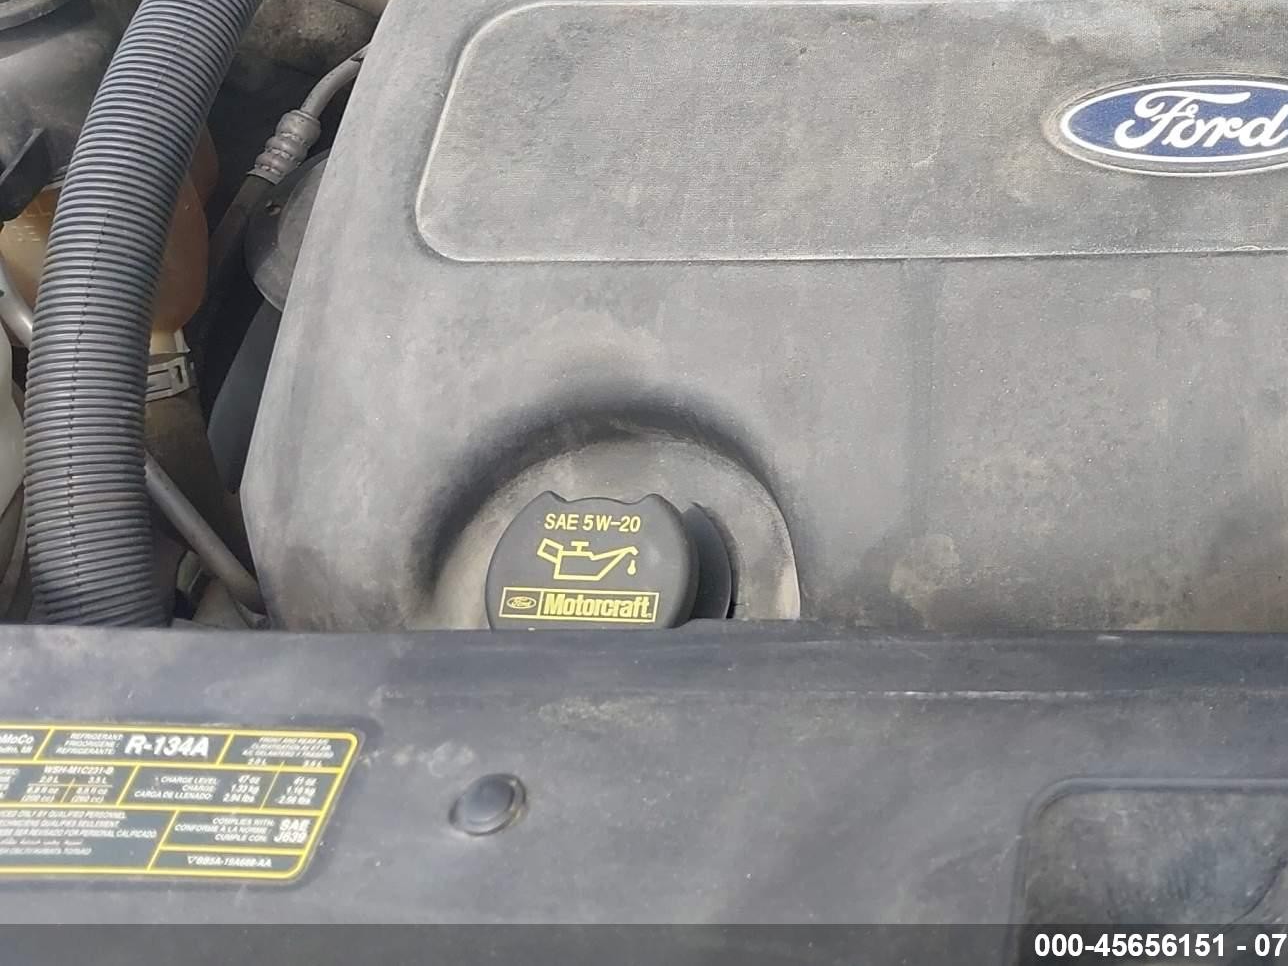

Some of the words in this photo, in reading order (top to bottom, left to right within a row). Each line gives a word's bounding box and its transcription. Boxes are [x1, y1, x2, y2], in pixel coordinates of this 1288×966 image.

[544, 513, 580, 531] SAE
[583, 514, 641, 532] 5W-20
[543, 593, 653, 619] Motorcraft
[124, 733, 210, 757] R-134A
[160, 775, 193, 785] CHARGE
[134, 790, 162, 799] CARGA
[279, 818, 311, 832] SAE
